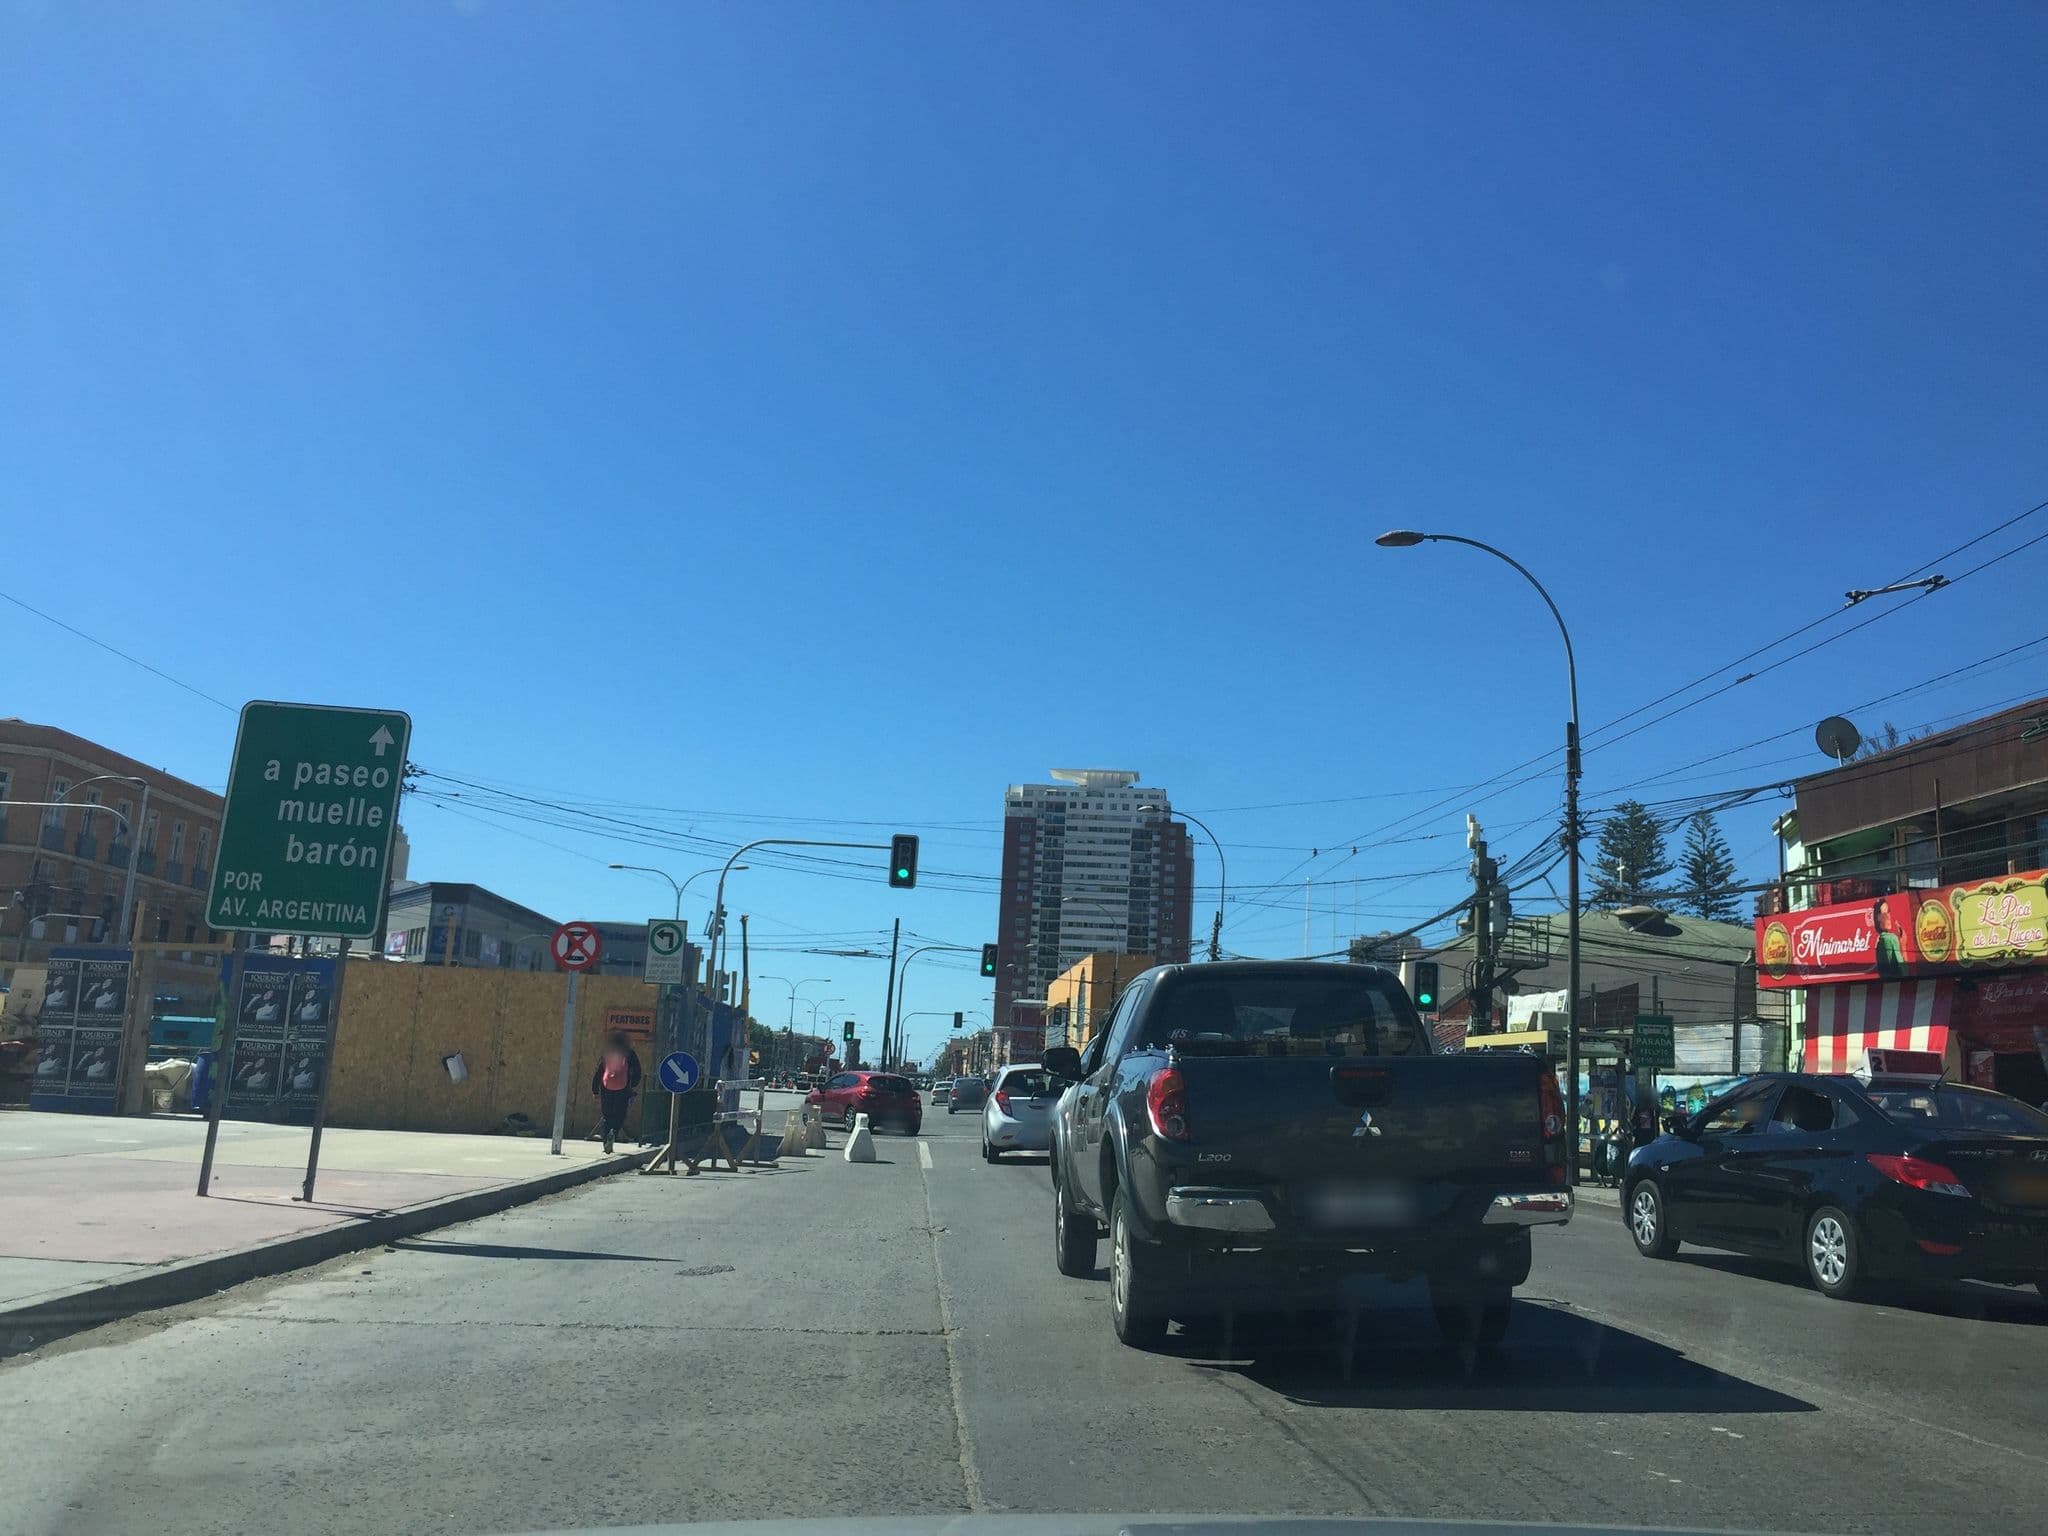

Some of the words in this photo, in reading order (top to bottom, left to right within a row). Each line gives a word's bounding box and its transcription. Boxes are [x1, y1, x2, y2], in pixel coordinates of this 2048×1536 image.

[264, 760, 281, 781] a
[294, 762, 389, 790] paseo
[278, 798, 383, 828] muelle
[286, 834, 377, 868] barón
[223, 871, 263, 891] POR
[219, 897, 249, 917] AV.
[257, 900, 367, 924] ARGENTINA
[1979, 895, 2001, 926] La
[1797, 927, 1872, 968] Minimarket
[1974, 931, 1984, 946] de
[1988, 927, 1998, 945] la
[1198, 1153, 1232, 1162] L200
